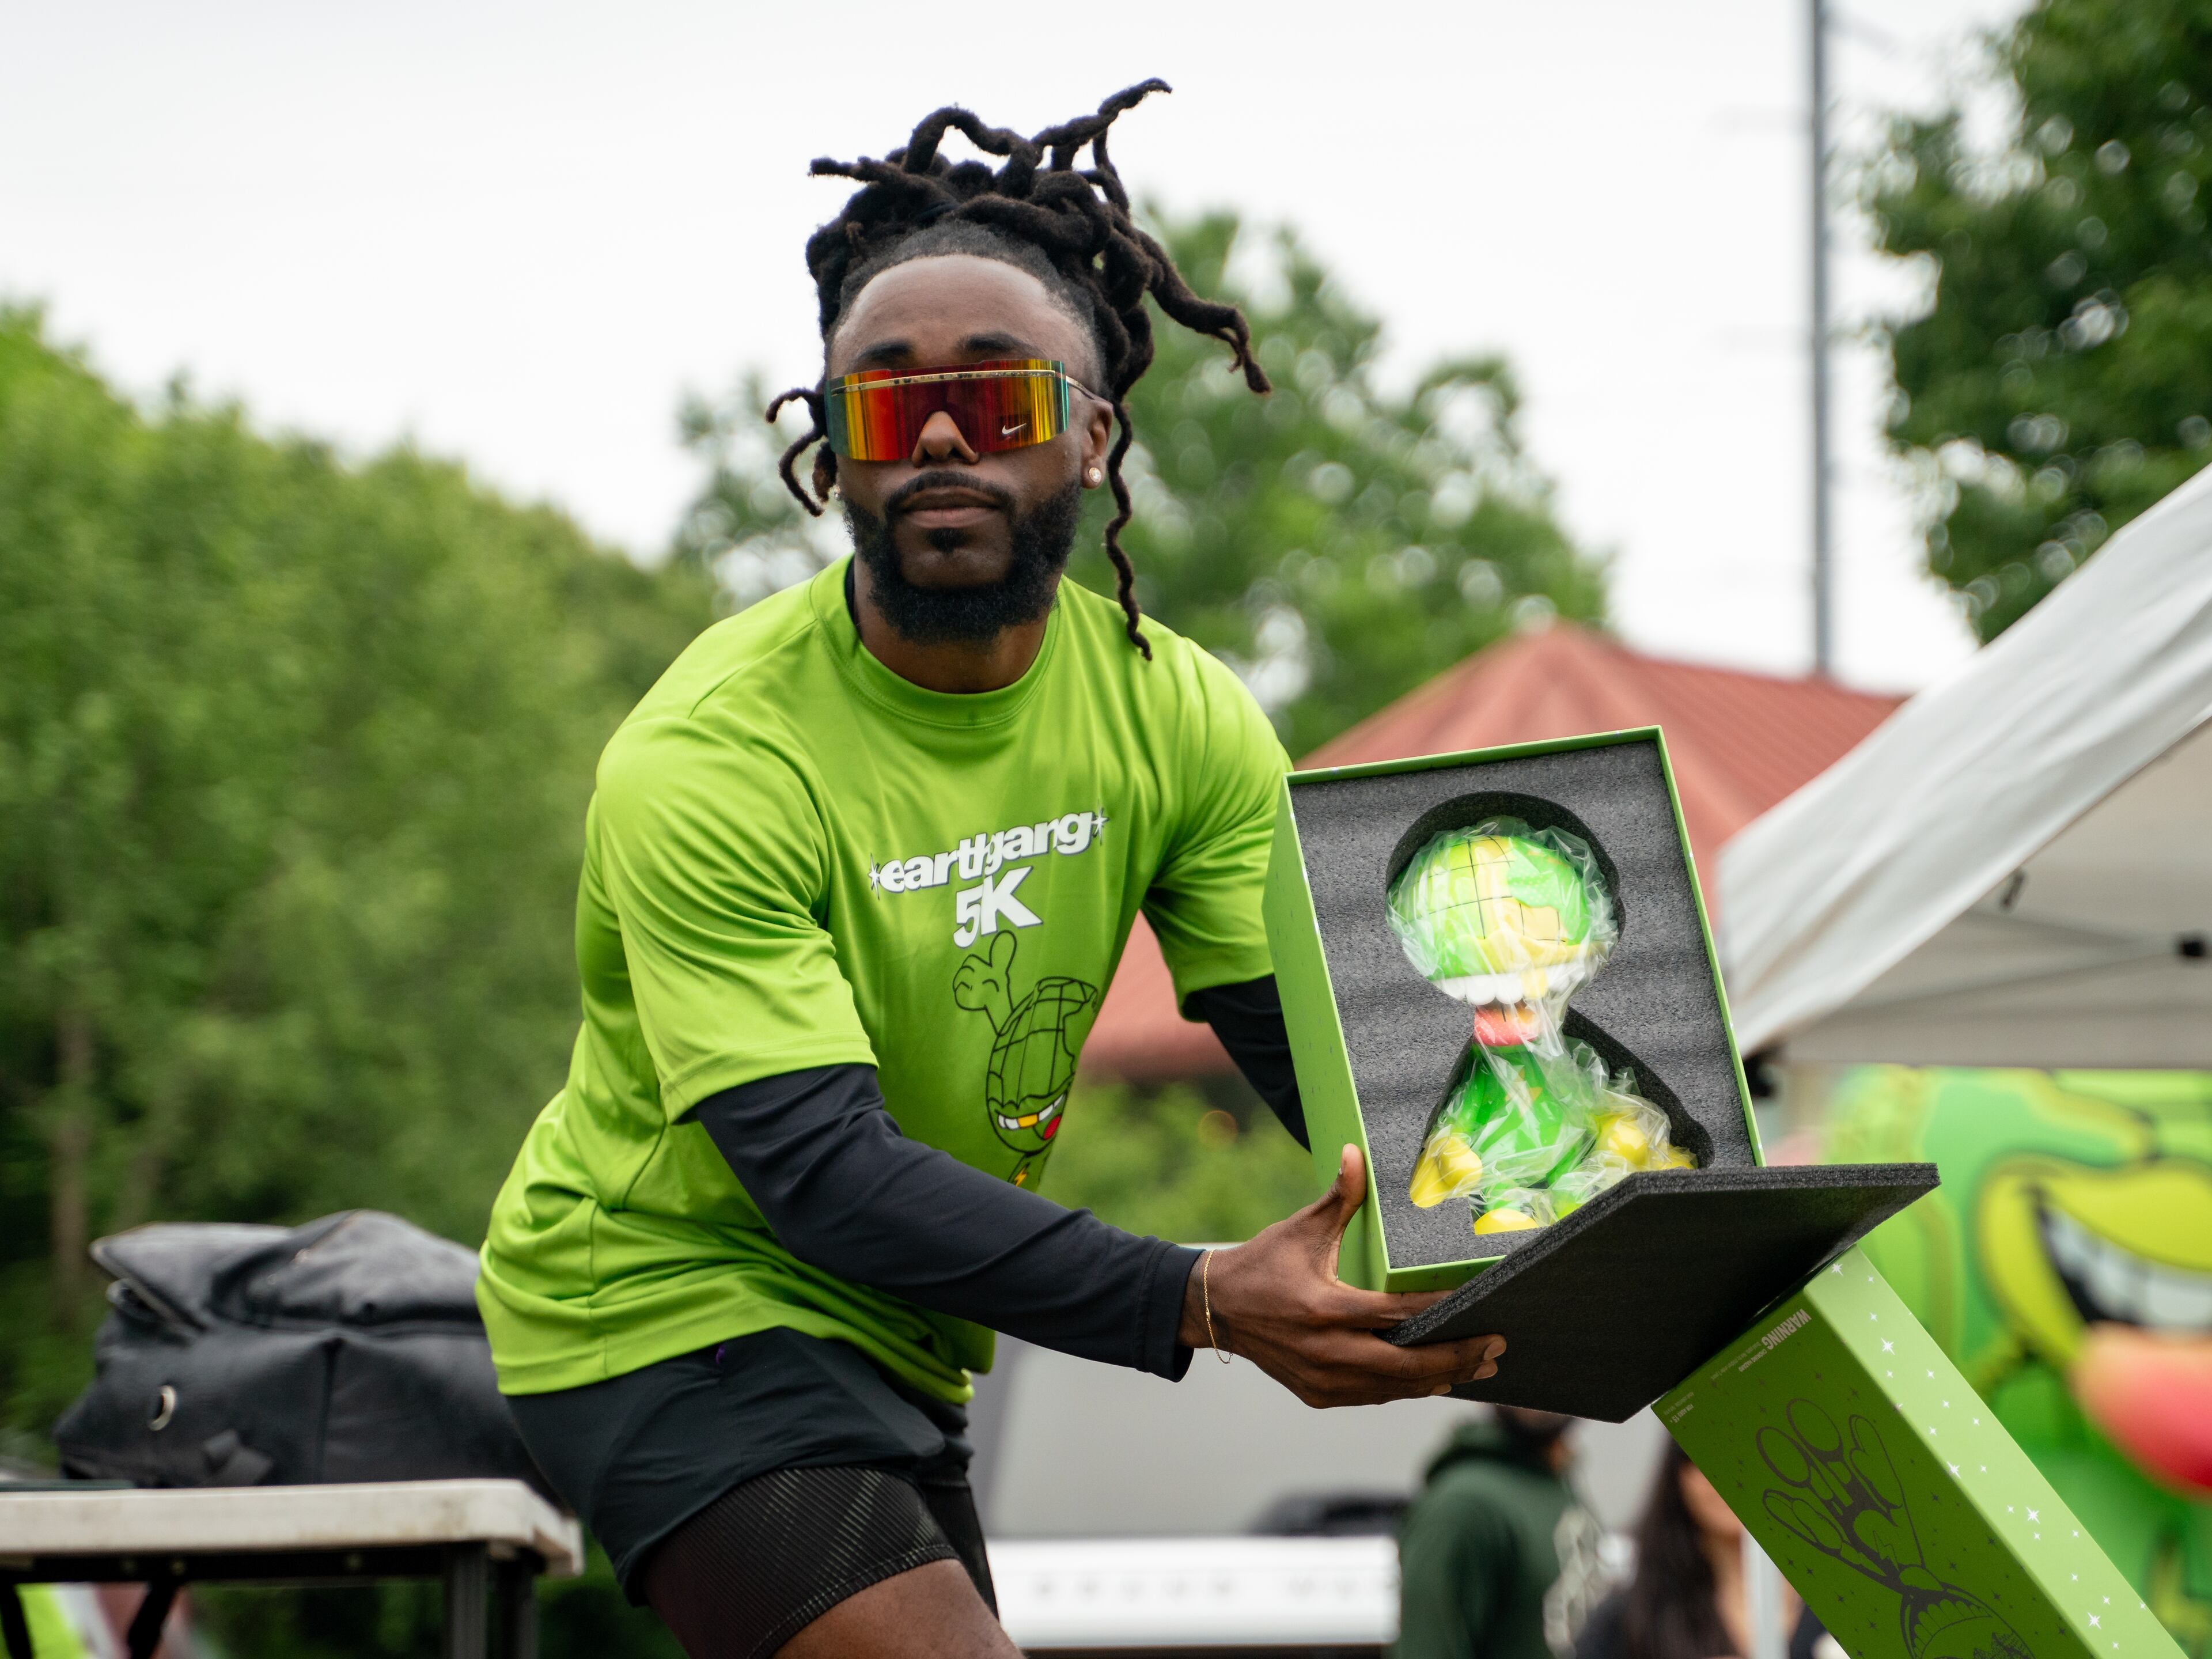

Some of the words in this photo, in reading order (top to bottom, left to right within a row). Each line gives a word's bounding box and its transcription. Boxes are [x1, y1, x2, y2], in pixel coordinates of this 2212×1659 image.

[879, 811, 1094, 893] earthgang
[953, 866, 1043, 949] 5K
[1762, 1308, 1812, 1350] WARNING
